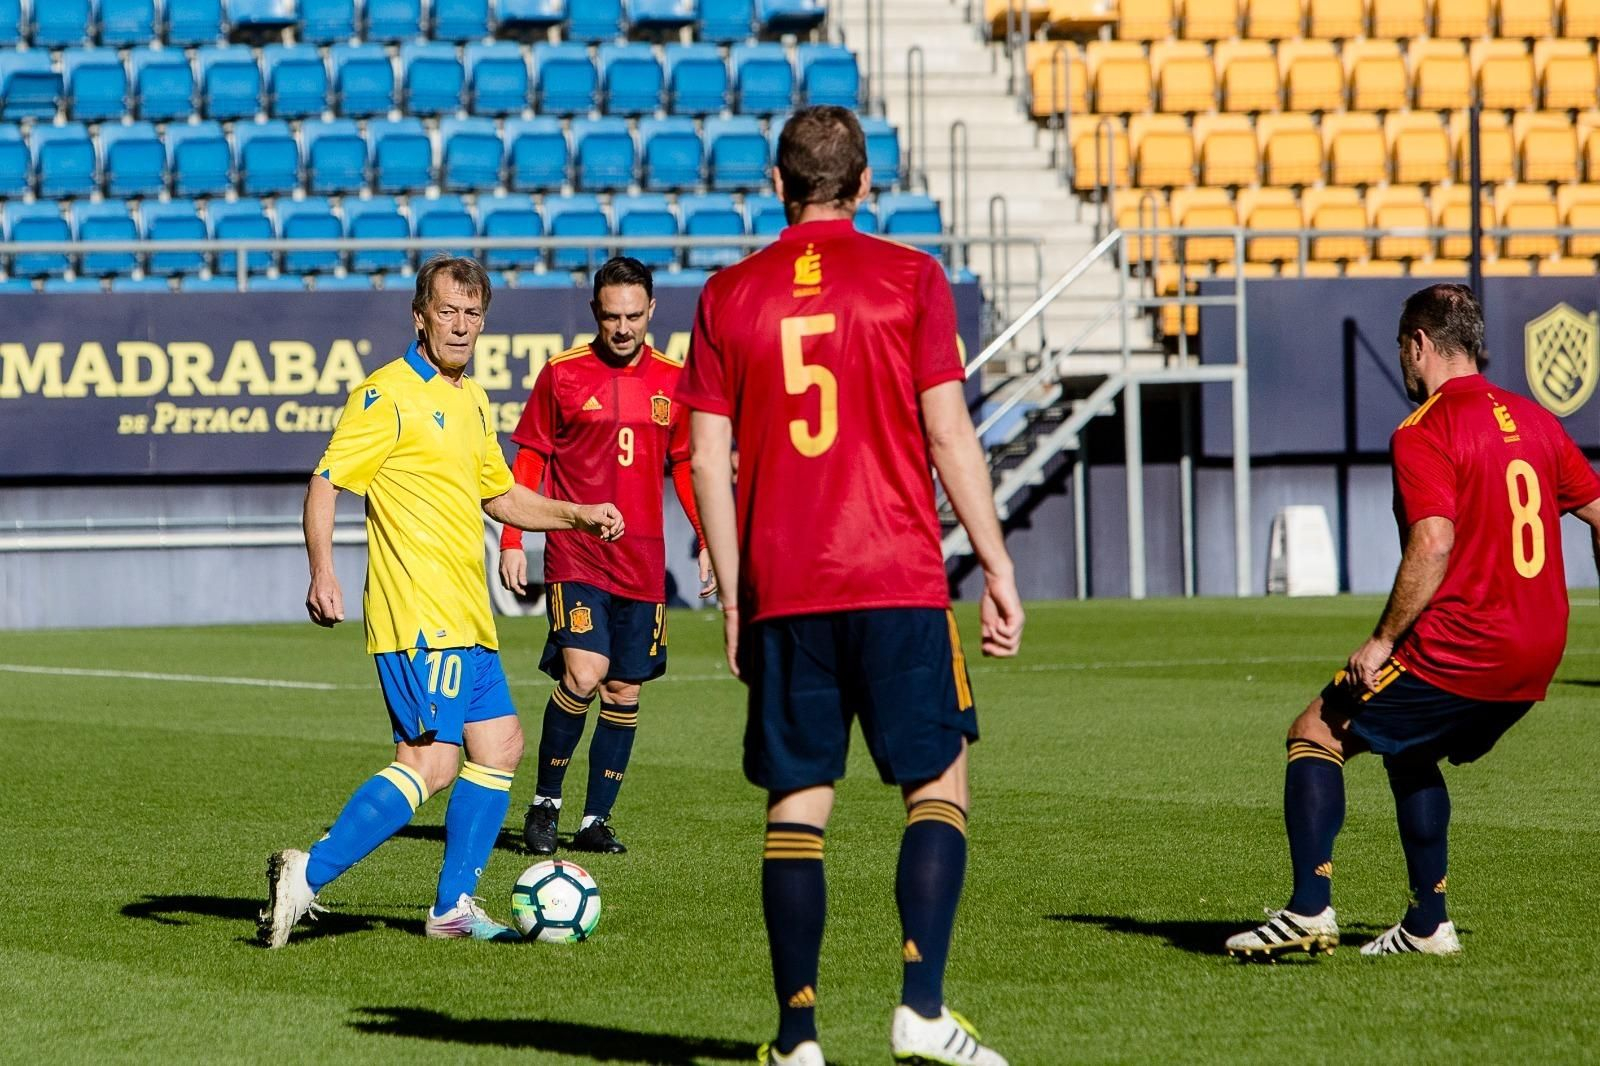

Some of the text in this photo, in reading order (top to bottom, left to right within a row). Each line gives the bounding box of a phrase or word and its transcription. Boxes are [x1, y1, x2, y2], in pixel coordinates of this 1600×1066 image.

[781, 313, 838, 458] 5
[117, 414, 148, 434] DE
[151, 401, 270, 434] PETACA
[618, 427, 635, 467] 9
[1506, 459, 1546, 579] 8
[653, 603, 663, 640] 9
[425, 651, 462, 699] 10
